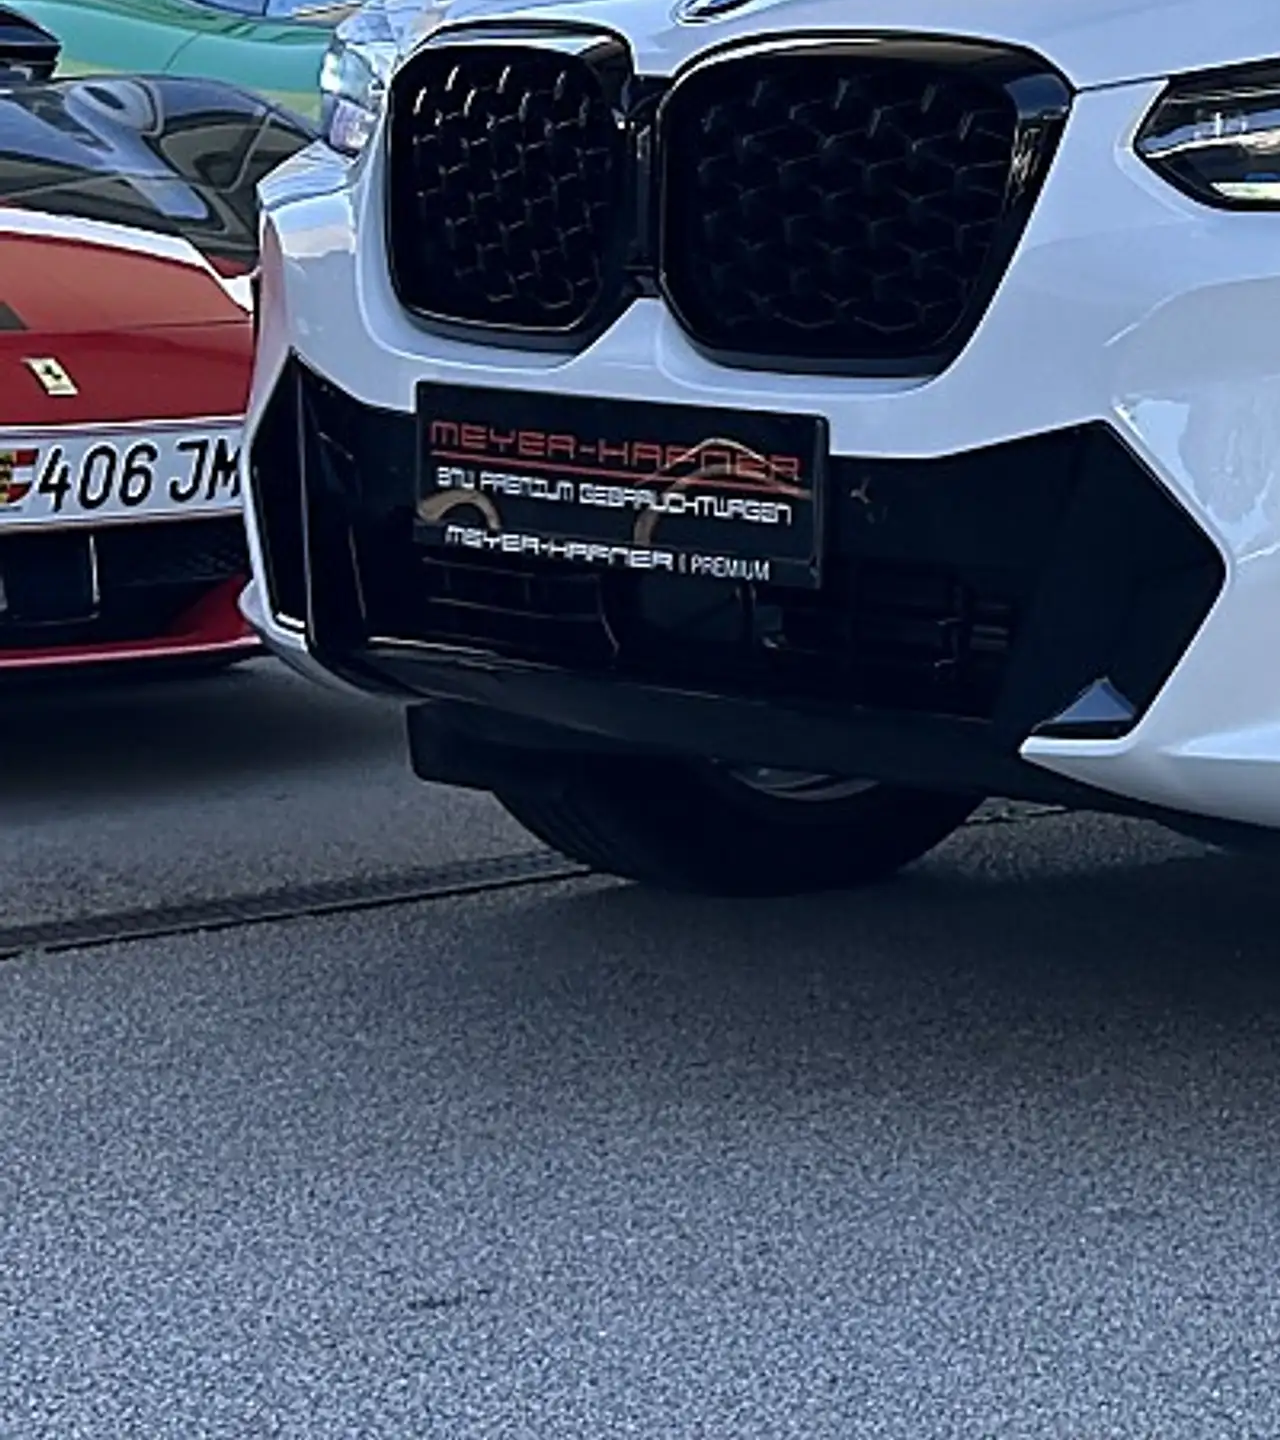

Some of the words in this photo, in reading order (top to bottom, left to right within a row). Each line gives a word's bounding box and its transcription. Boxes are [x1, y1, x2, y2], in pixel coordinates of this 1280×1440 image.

[38, 444, 160, 512] 406
[169, 438, 242, 502] JM
[430, 420, 802, 482] MEYER-HAFNER
[480, 470, 575, 503] PREMIUM
[578, 482, 793, 524] GEBRAUCHTWAGEN
[445, 524, 674, 573] MEYER-HAFNER
[690, 554, 771, 582] PREMIUM
